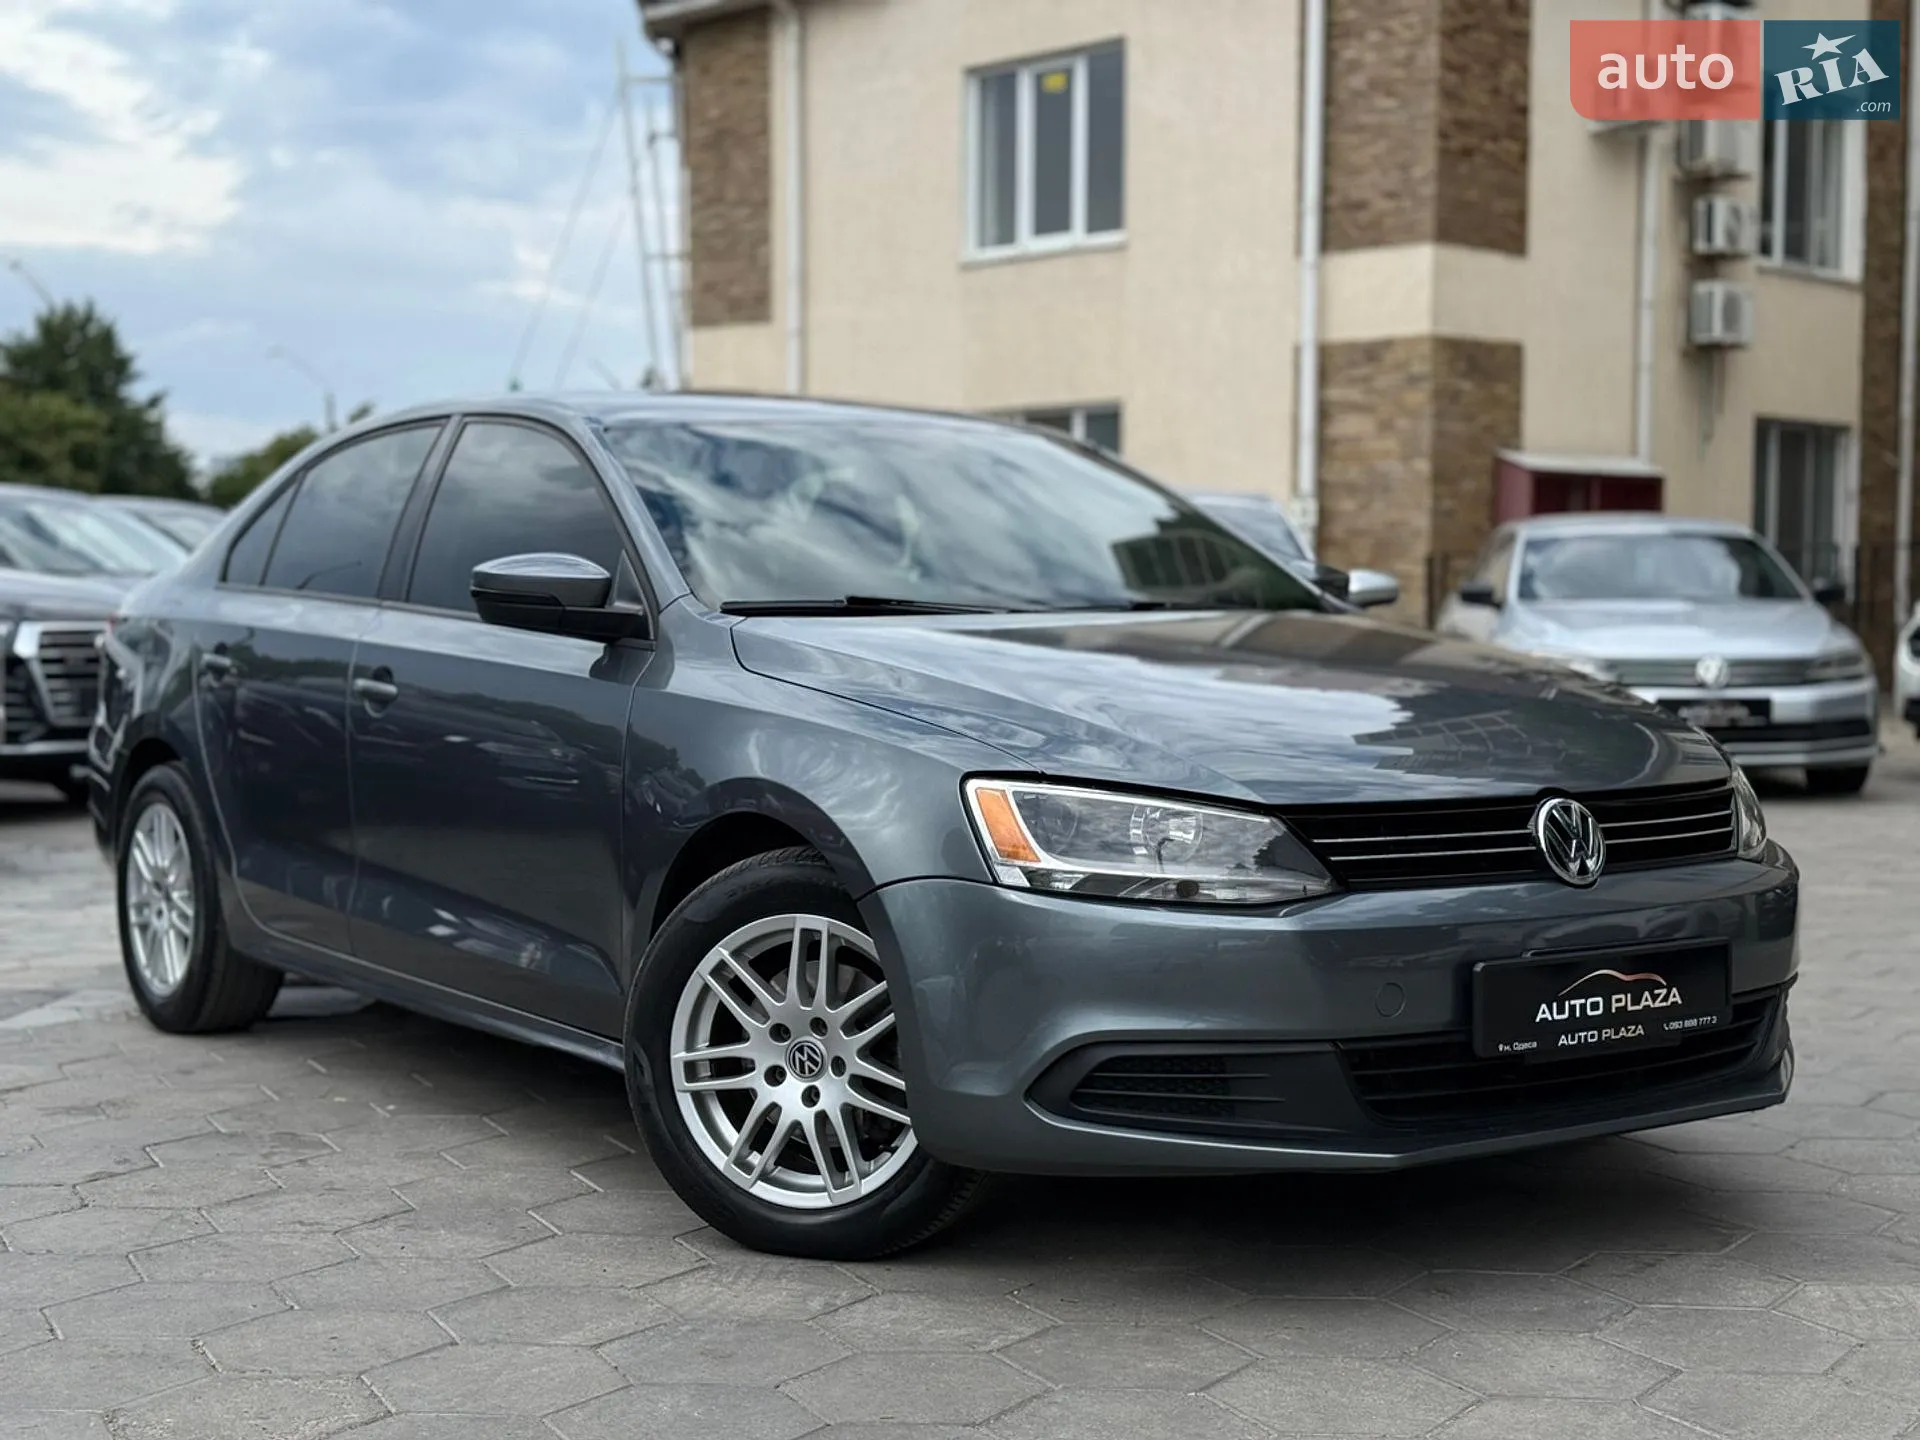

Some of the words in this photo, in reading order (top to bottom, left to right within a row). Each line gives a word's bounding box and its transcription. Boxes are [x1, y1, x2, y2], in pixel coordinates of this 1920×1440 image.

[1535, 997, 1604, 1022] AUTO
[1611, 987, 1683, 1013] PLAZA
[1558, 1030, 1598, 1047] AUTO
[1601, 1024, 1645, 1041] PLAZA
